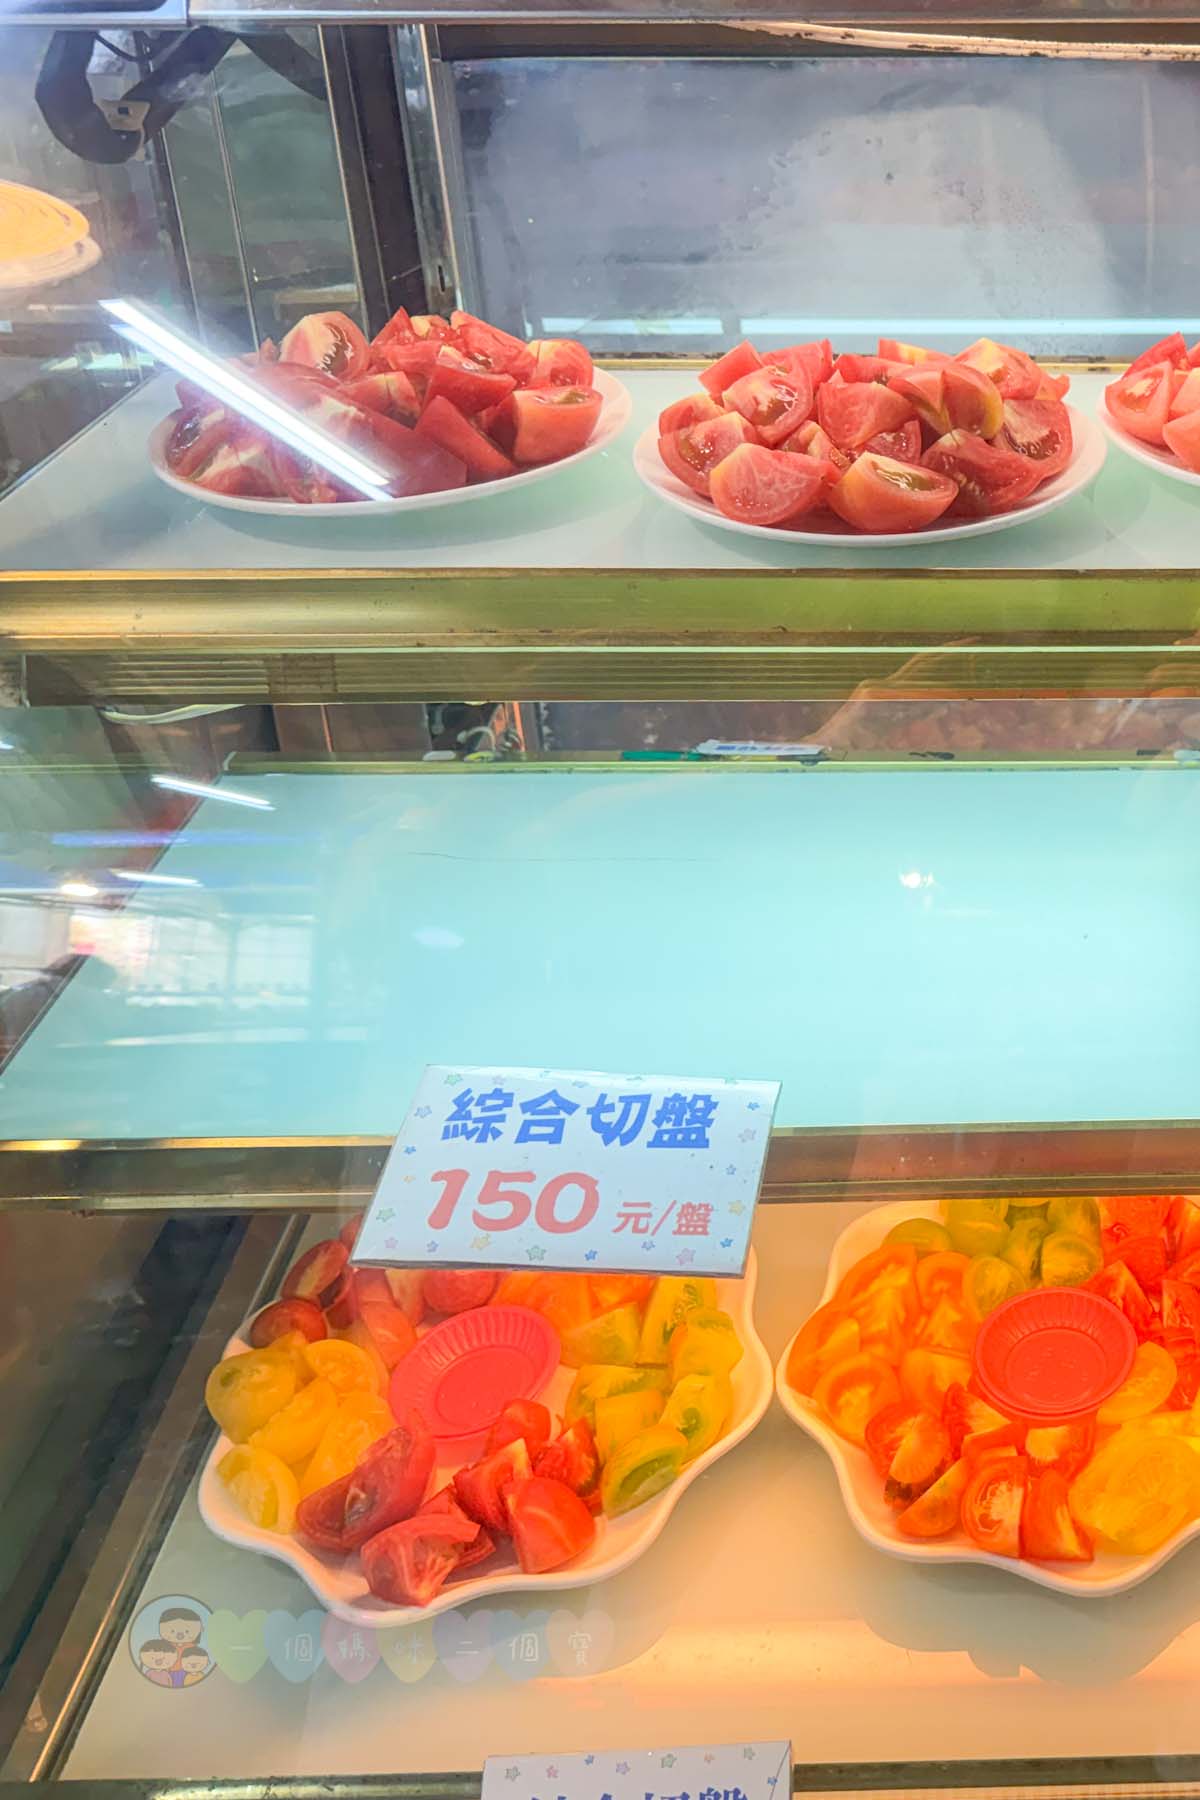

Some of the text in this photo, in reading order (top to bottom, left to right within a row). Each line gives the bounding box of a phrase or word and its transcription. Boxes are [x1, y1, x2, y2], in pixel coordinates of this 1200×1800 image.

[441, 1088, 719, 1149] 綜合切盤
[427, 1169, 714, 1236] 150 元/盤
